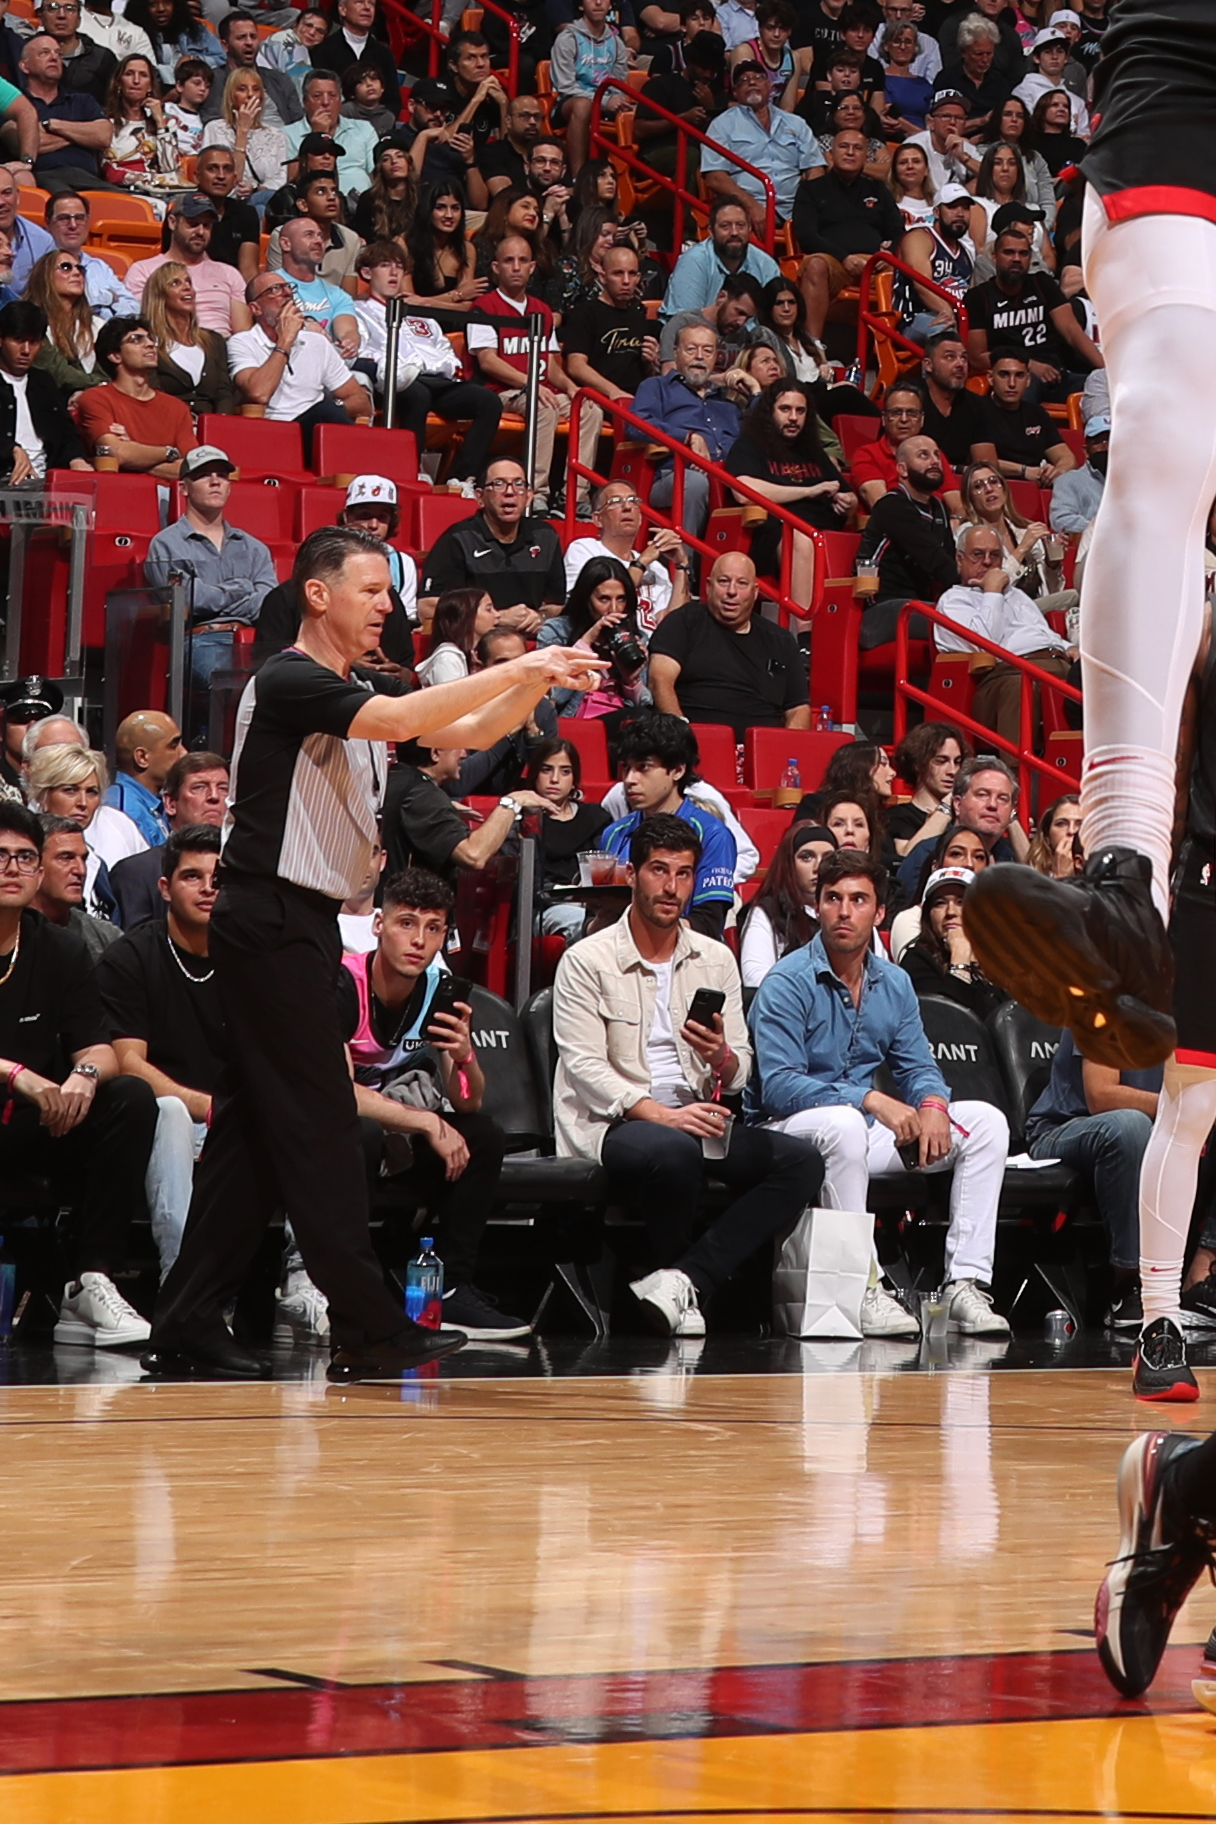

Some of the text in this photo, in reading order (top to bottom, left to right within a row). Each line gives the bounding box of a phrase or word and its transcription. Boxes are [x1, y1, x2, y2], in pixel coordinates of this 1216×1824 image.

[993, 306, 1045, 330] MIAMI
[1022, 324, 1047, 347] 22
[406, 1040, 424, 1051] UK
